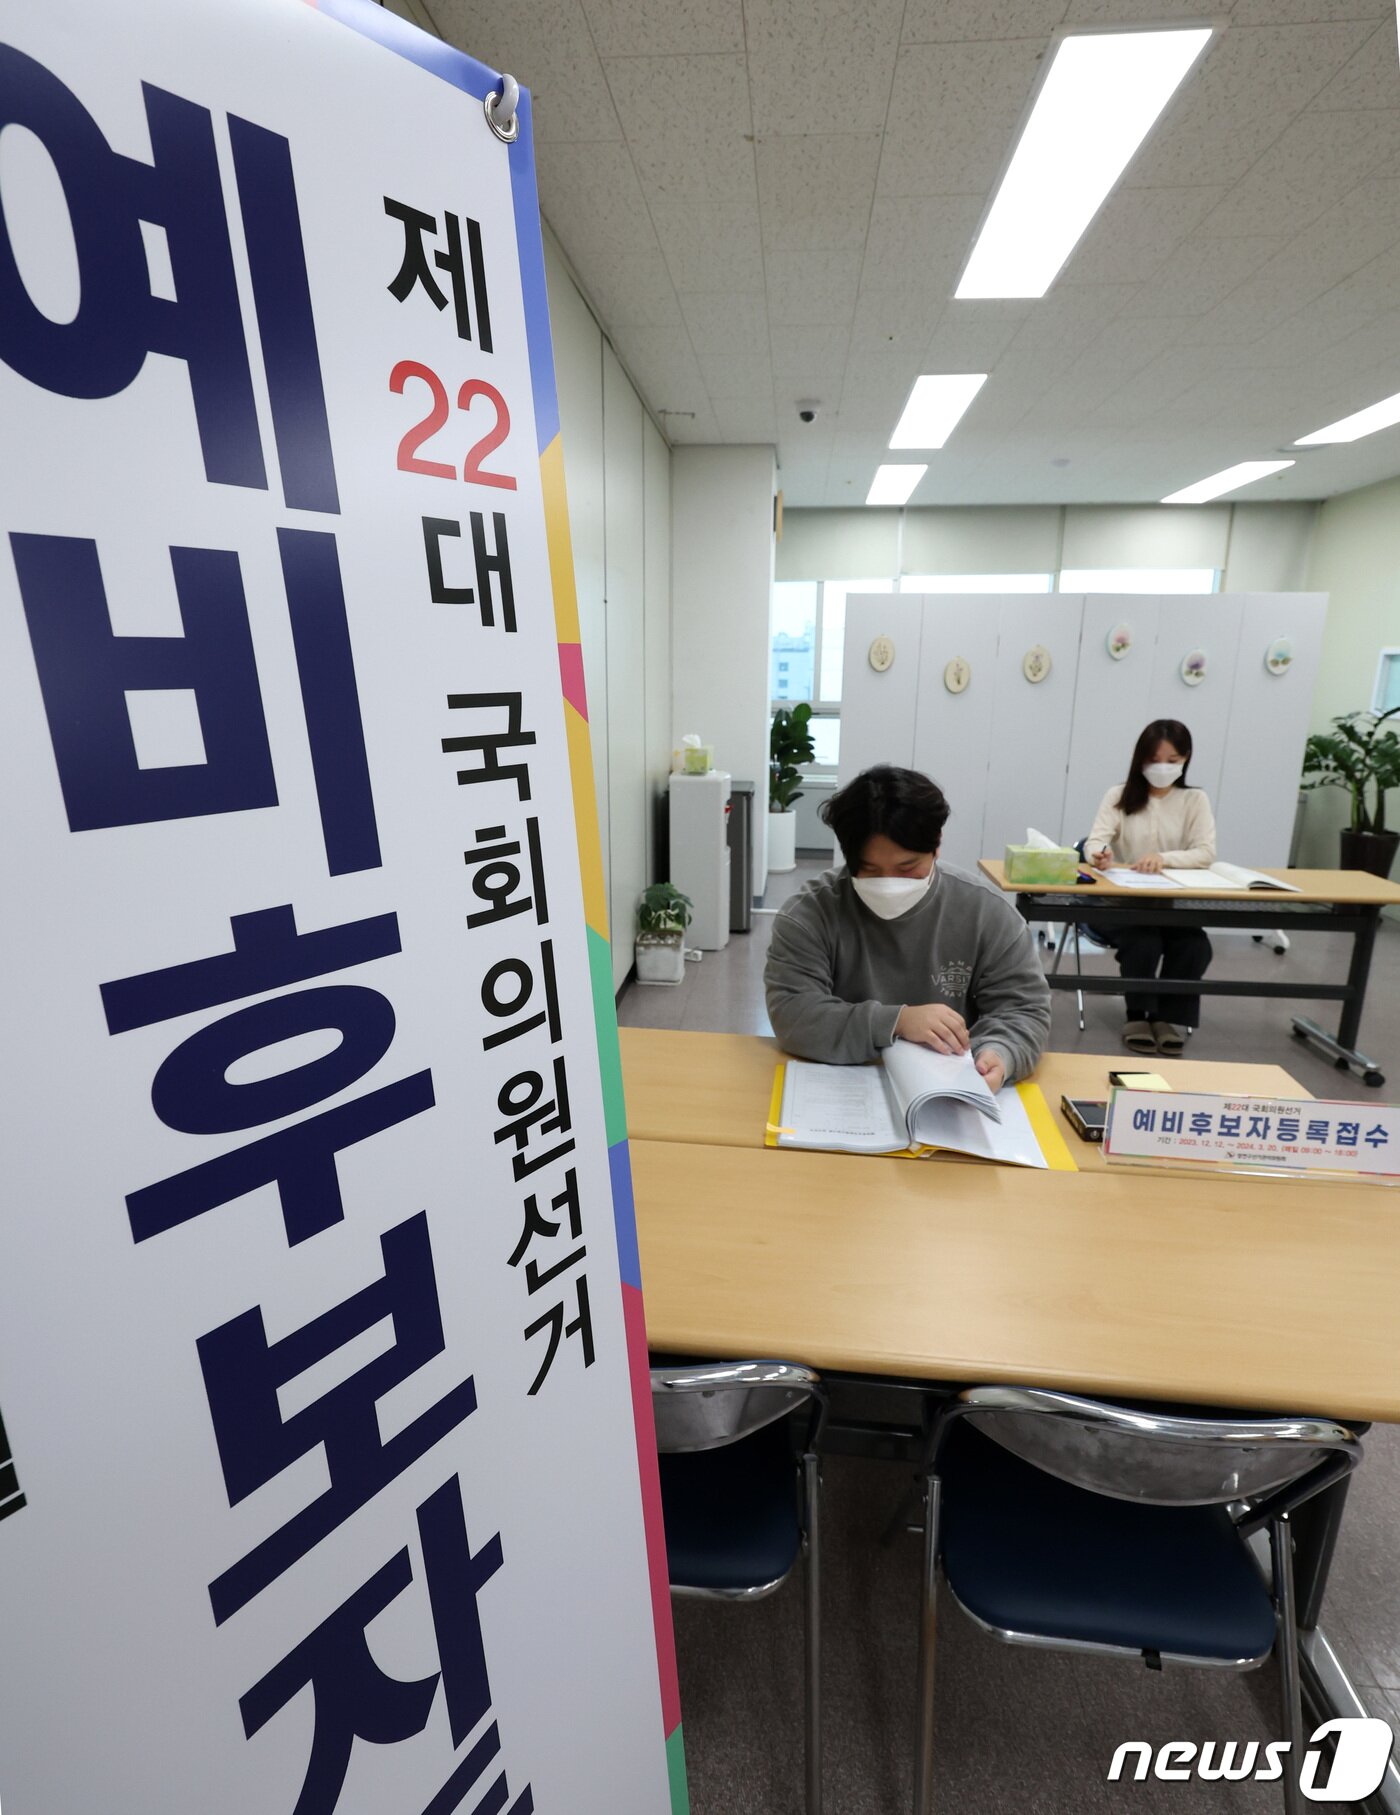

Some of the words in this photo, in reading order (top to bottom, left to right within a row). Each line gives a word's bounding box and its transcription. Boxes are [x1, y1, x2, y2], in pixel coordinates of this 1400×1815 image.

[383, 195, 518, 633] 제22대
[931, 974, 971, 986] VARSIT
[441, 691, 596, 1396] 국회의원선거
[1224, 1103, 1249, 1112] 제22대
[1252, 1105, 1301, 1115] 국회의원선거
[1133, 1108, 1389, 1148] 예비후보자등록접수
[1157, 1137, 1171, 1145] 기간
